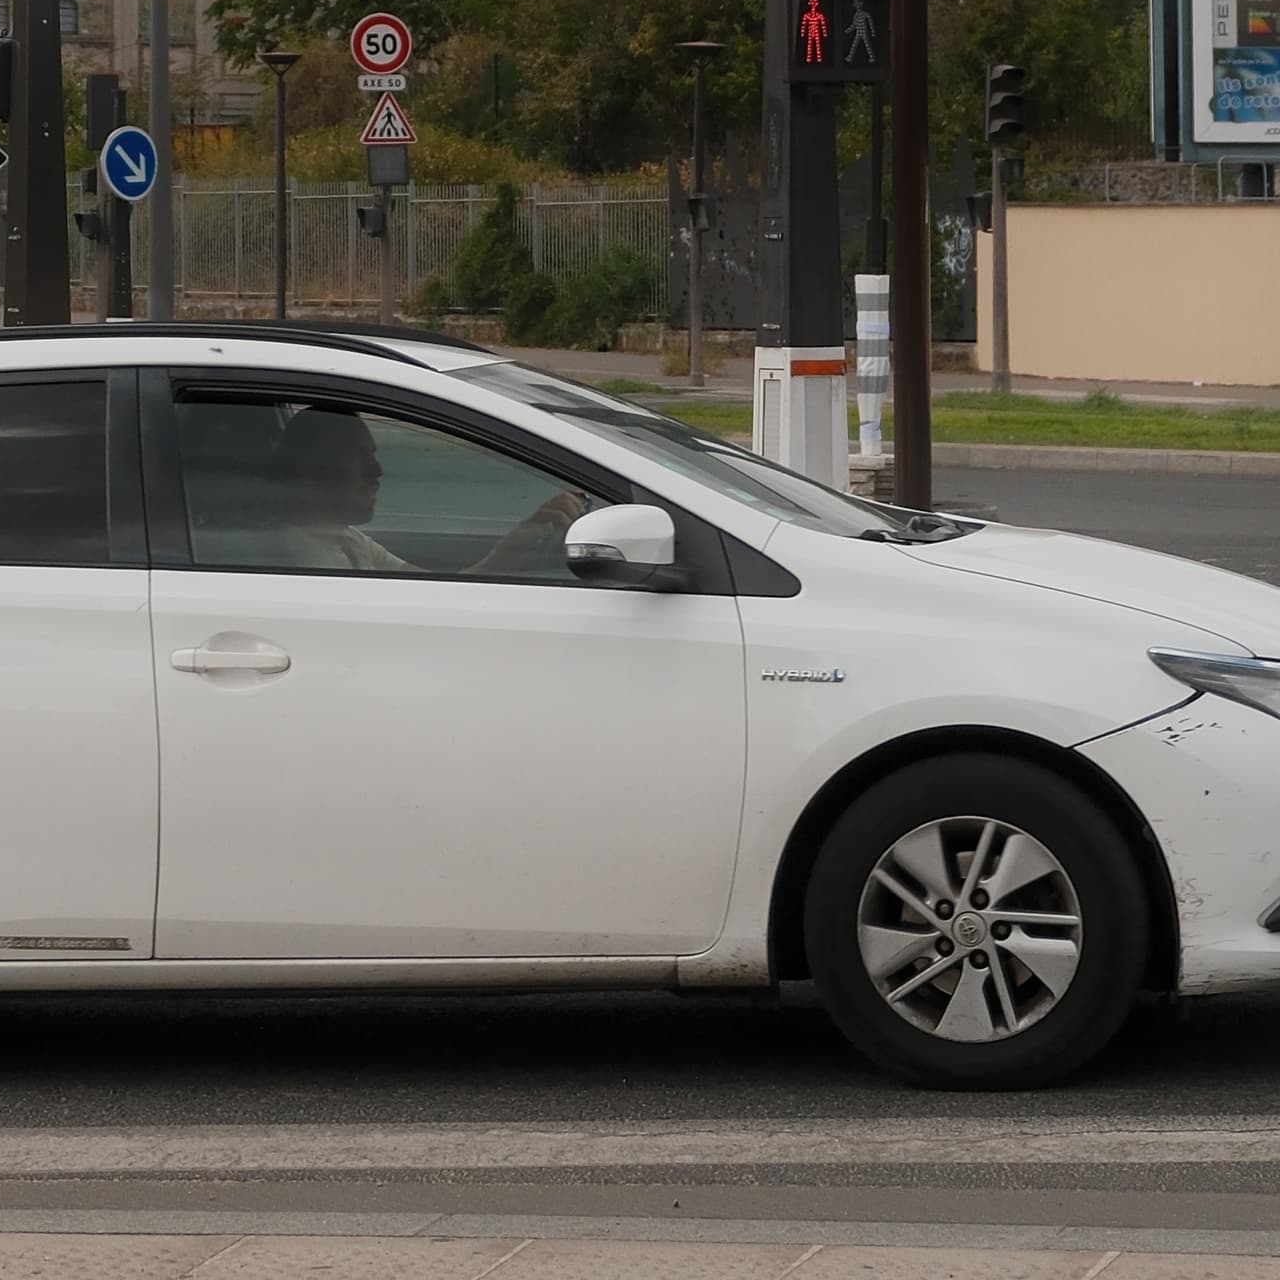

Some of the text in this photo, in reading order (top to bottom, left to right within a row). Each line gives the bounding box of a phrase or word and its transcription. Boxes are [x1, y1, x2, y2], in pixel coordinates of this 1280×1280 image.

[366, 33, 397, 55] 50
[363, 79, 402, 88] AXE 50
[1219, 94, 1241, 109] de
[761, 669, 831, 682] HYBRID
